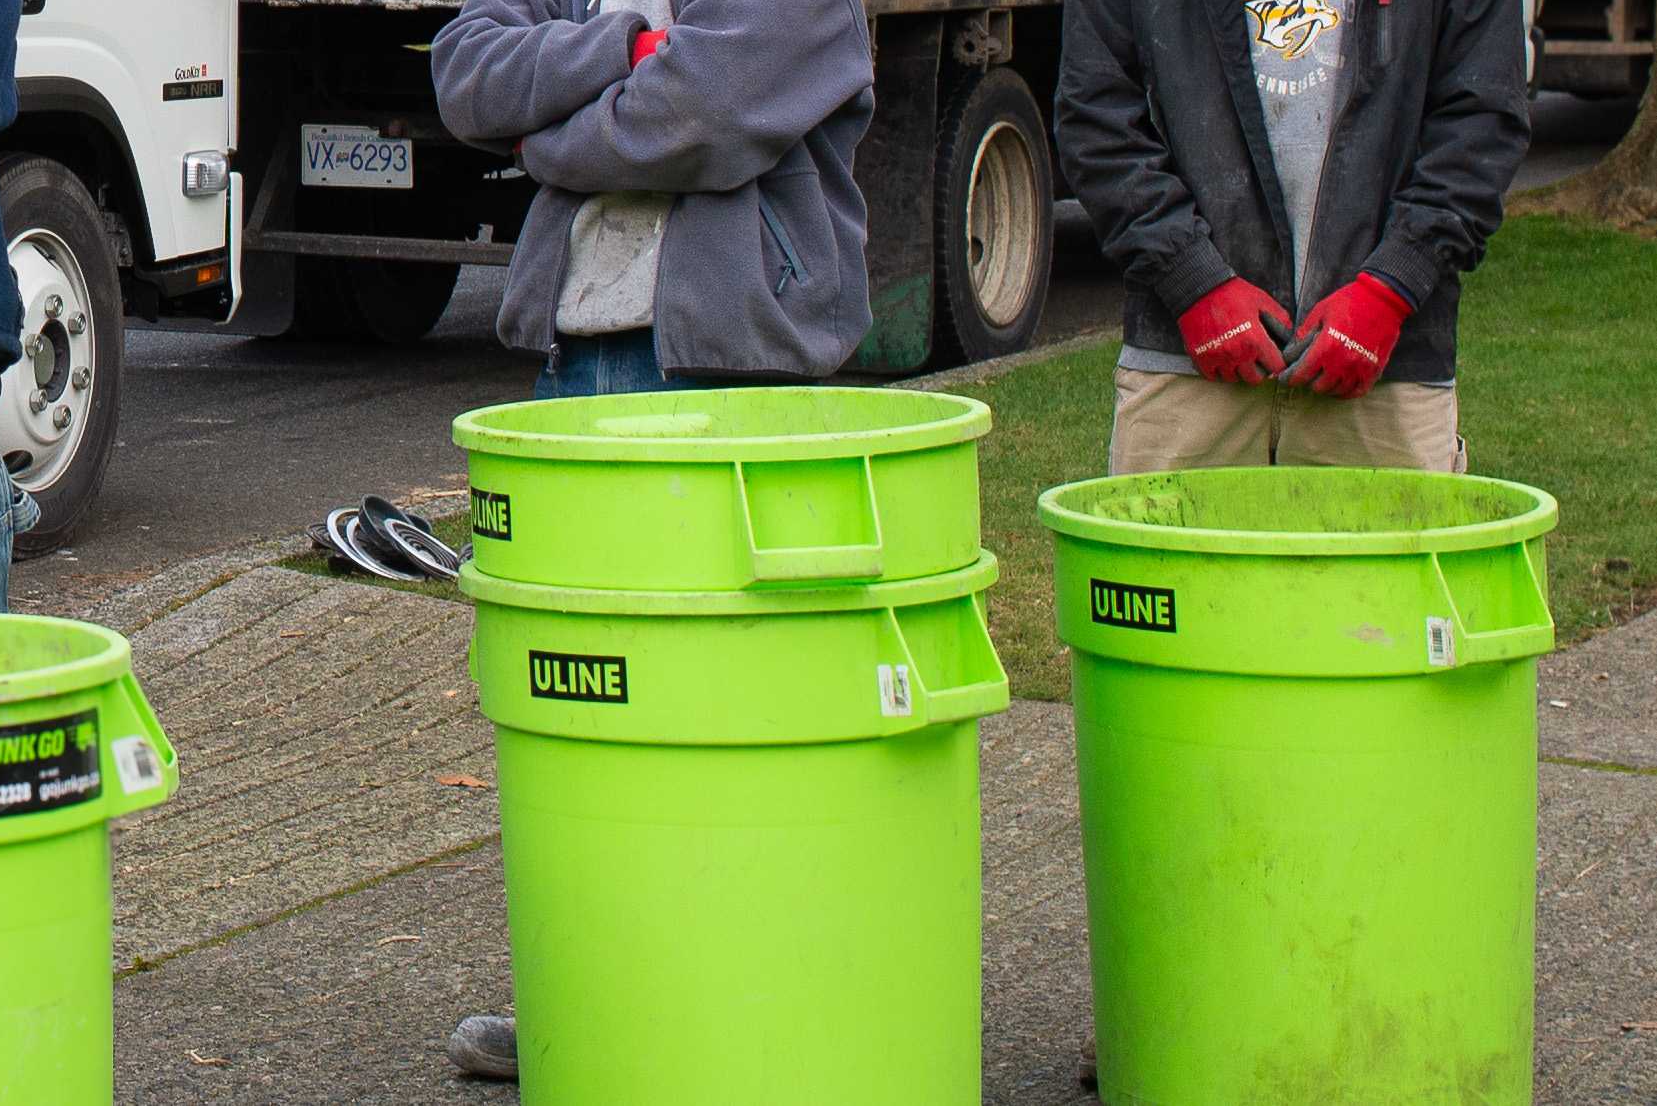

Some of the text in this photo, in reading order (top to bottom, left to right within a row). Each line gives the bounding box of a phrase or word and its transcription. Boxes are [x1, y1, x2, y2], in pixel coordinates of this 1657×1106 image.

[190, 82, 218, 97] NRR
[1255, 66, 1328, 96] ENNESSEE
[307, 142, 408, 173] VX 6293
[471, 494, 509, 534] ULINE
[1094, 586, 1170, 626] ULINE
[533, 658, 622, 697] ULINE
[37, 727, 66, 760] GO
